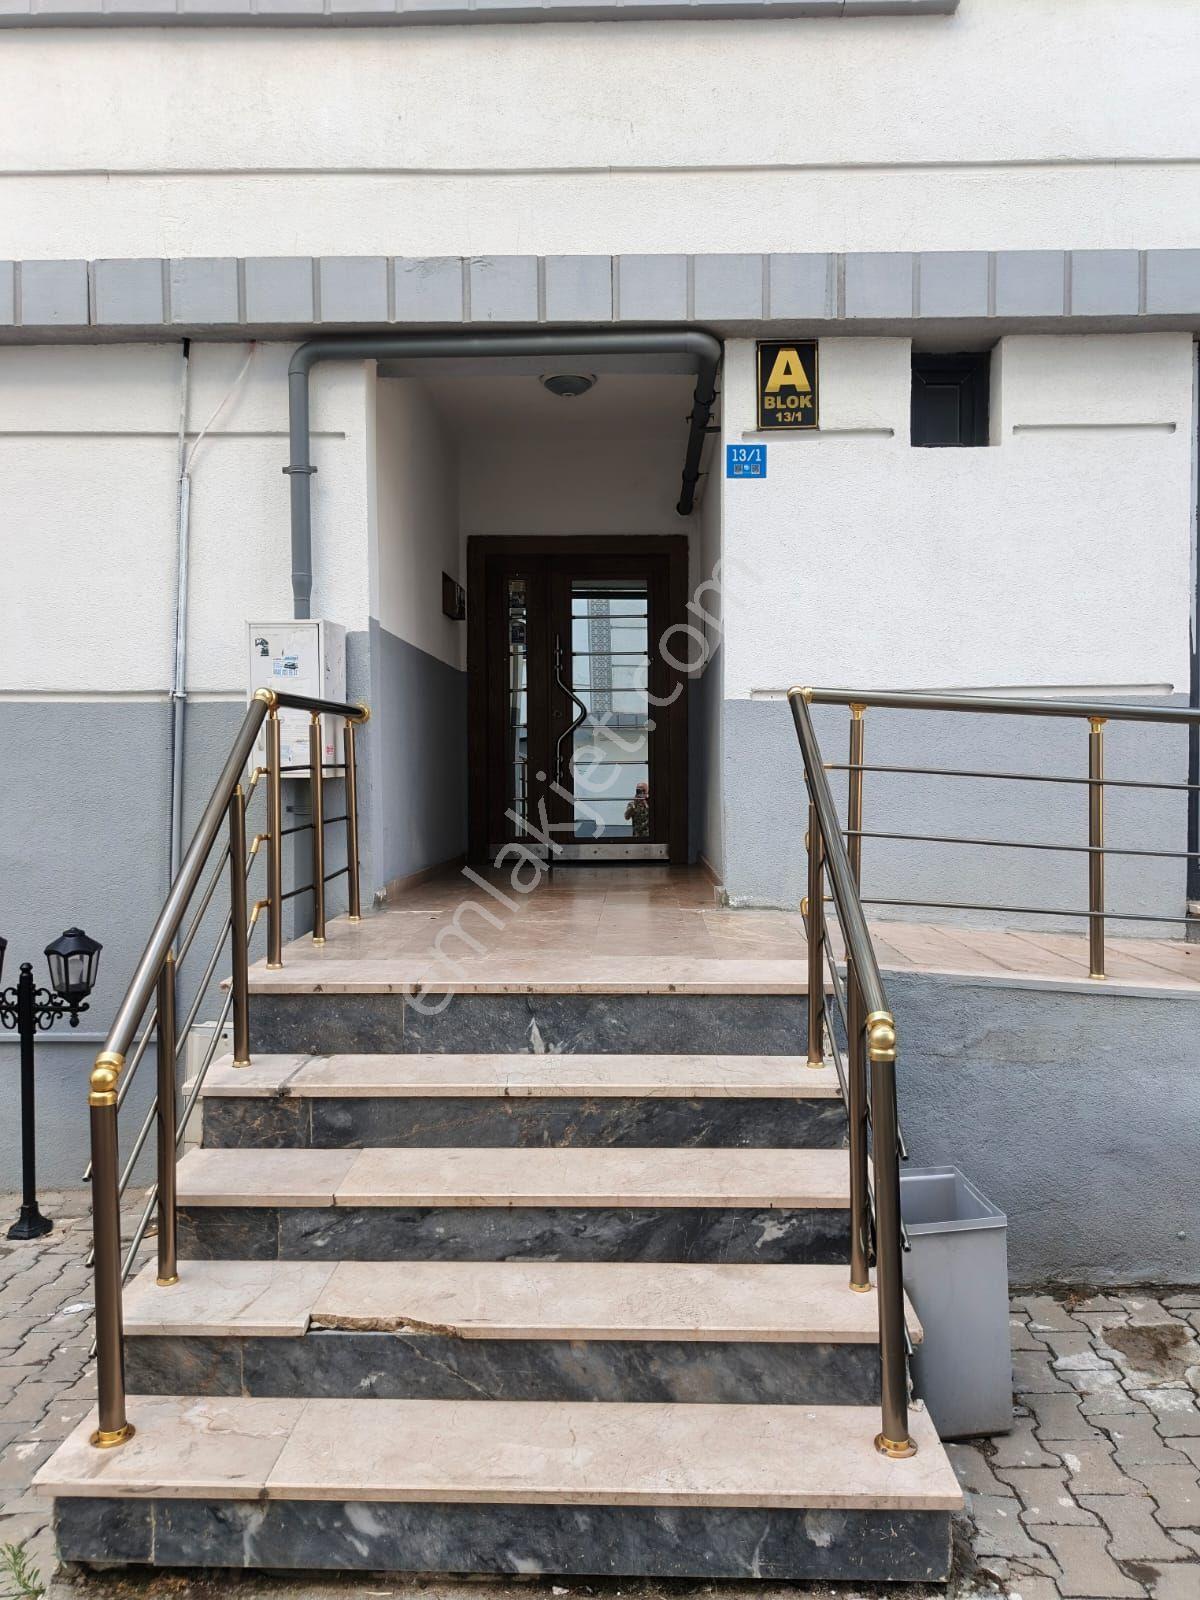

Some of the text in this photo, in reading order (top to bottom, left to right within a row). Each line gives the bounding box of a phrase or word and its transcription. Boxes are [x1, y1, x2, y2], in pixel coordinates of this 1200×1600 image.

[765, 347, 811, 393] A
[764, 395, 812, 409] BLOK
[775, 411, 802, 423] 13/1
[732, 448, 762, 462] 13/1
